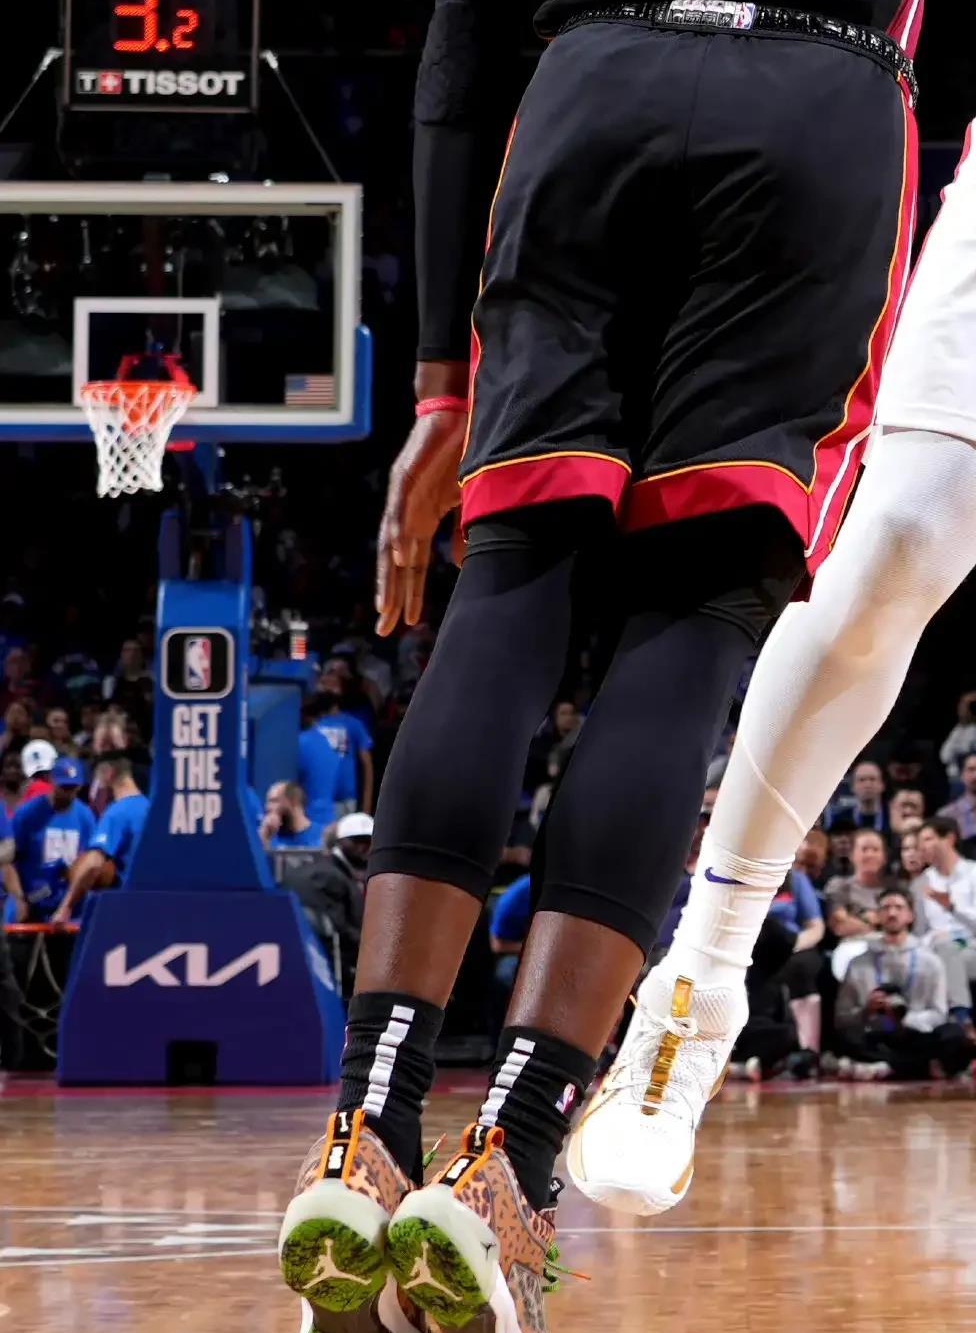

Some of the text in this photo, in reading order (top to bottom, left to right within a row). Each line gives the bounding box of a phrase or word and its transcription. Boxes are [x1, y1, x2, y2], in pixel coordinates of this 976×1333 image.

[123, 70, 246, 96] TISSOT
[172, 703, 222, 747] GET
[171, 748, 223, 790] THE
[168, 793, 222, 834] APP
